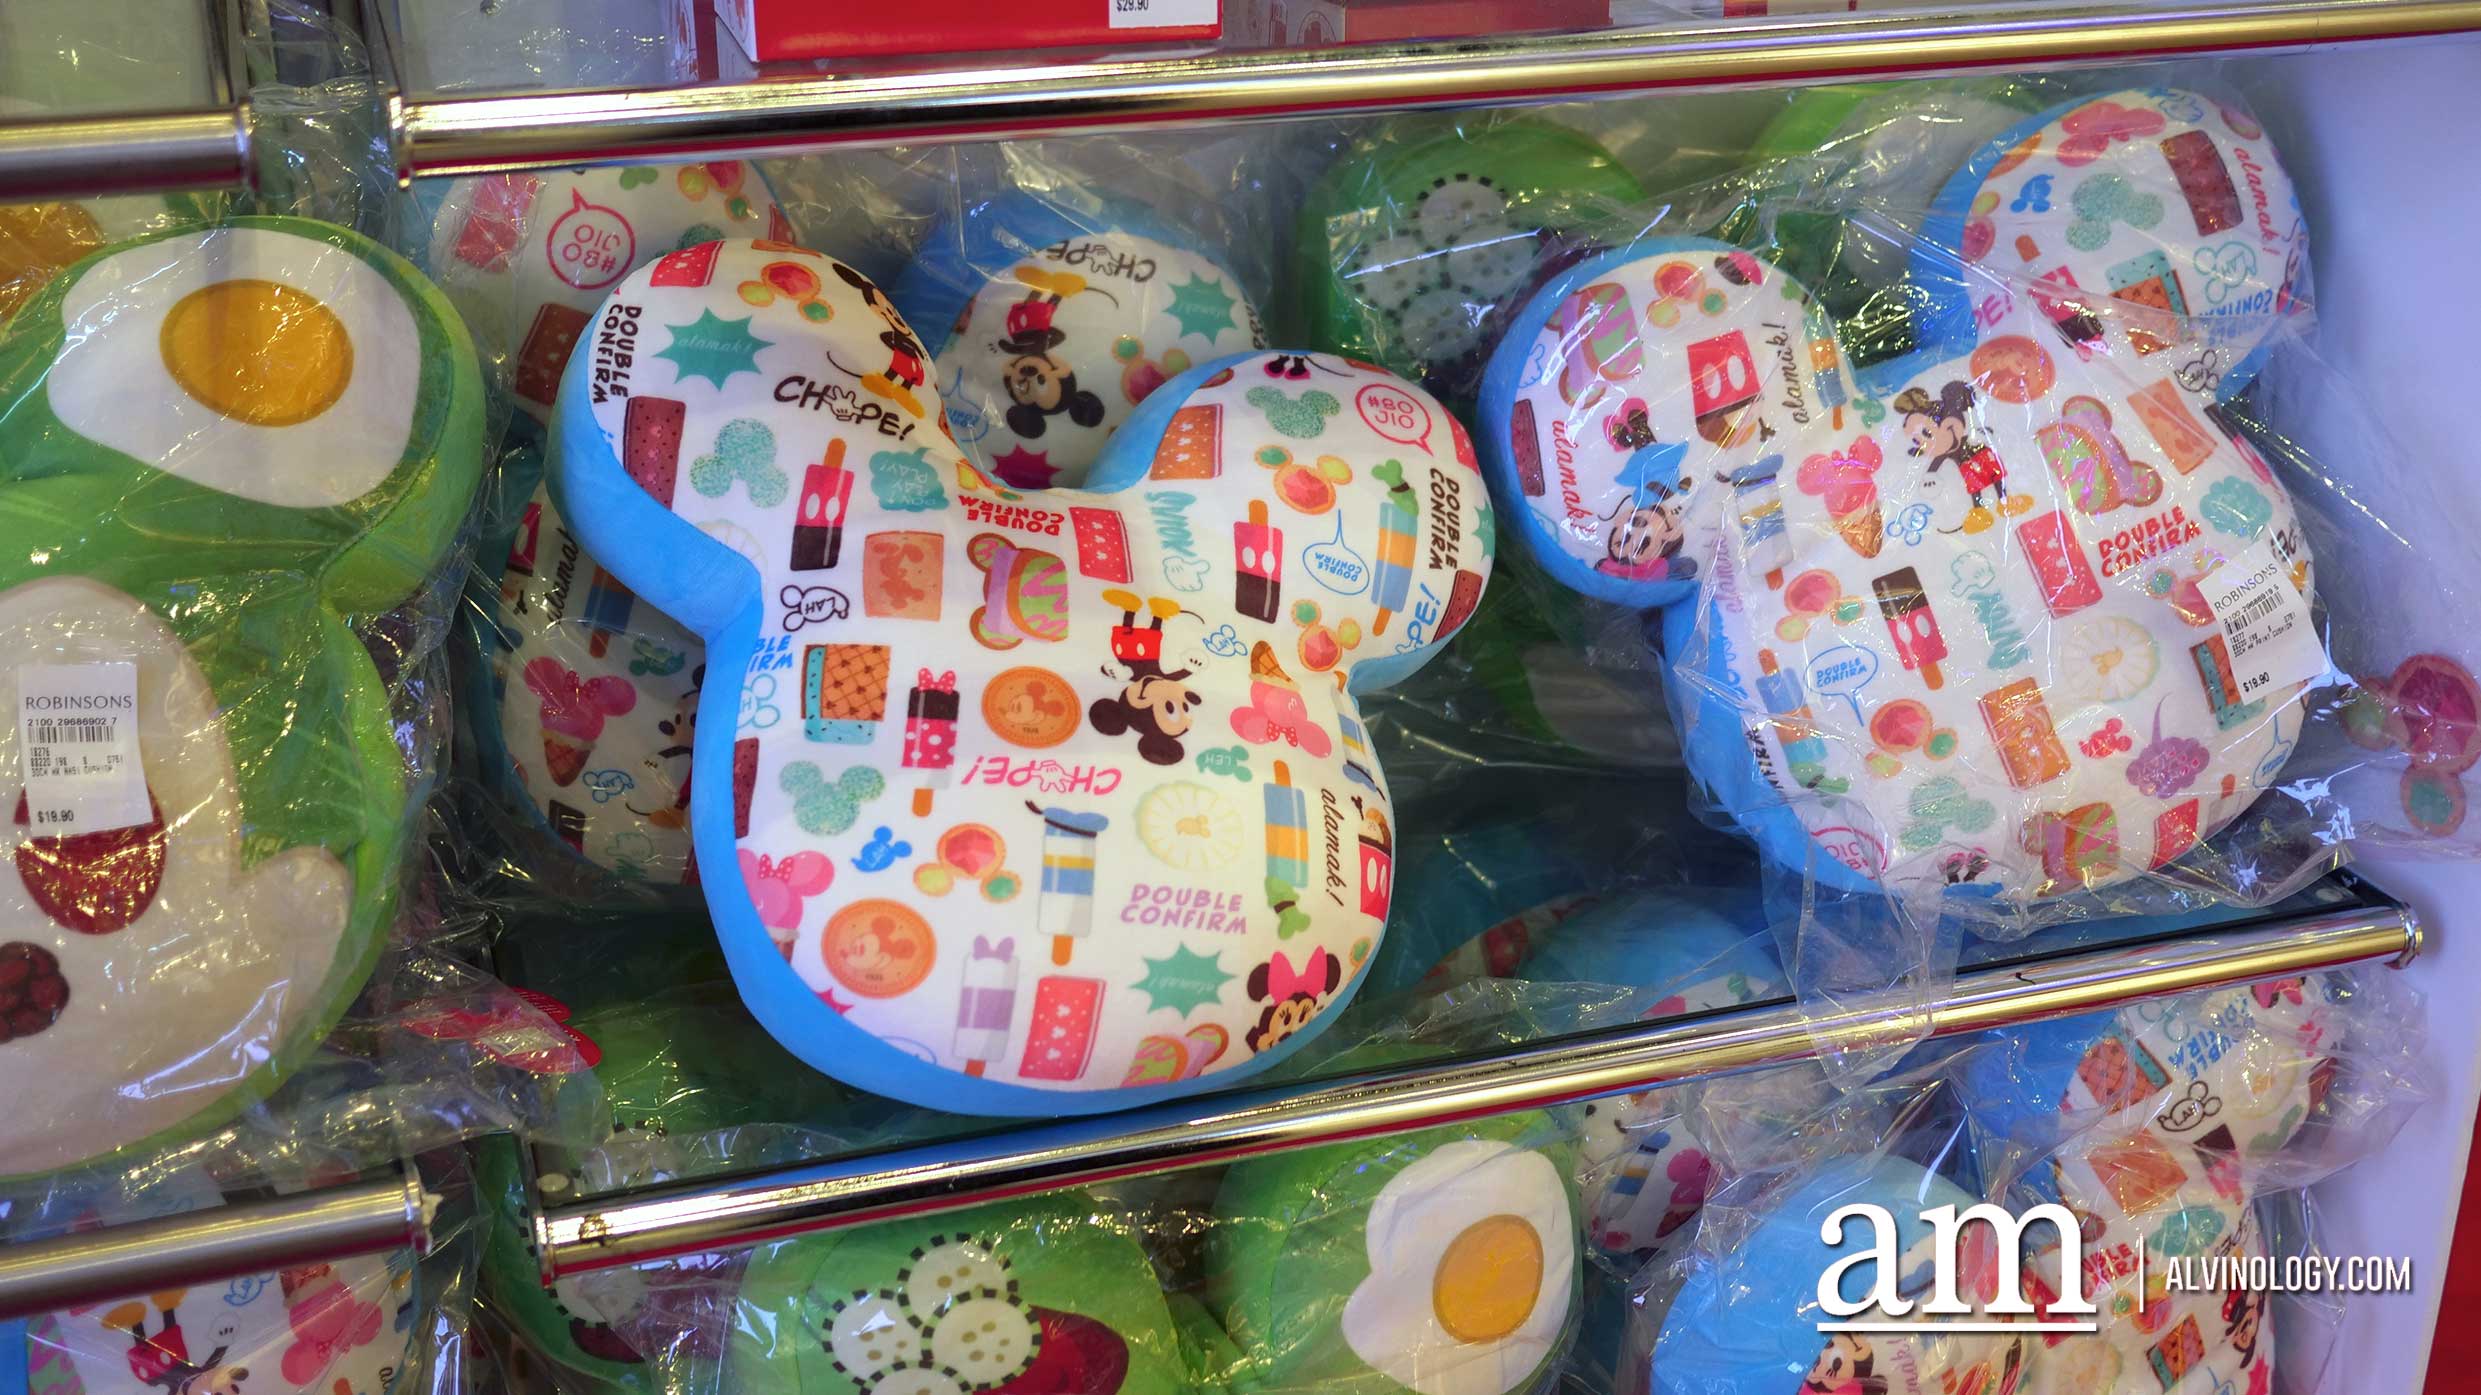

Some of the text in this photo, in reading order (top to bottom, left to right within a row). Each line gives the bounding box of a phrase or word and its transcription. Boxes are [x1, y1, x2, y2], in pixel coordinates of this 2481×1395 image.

[592, 303, 624, 405] CONFIRM
[610, 304, 643, 399] DOUBLE
[1368, 395, 1414, 416] #BO
[1374, 408, 1415, 431] JIO
[958, 495, 1065, 524] CONFIRM
[967, 509, 1061, 536] DOUBLE
[1428, 469, 1446, 572] CONFIRM
[1445, 479, 1461, 570] DOUBLE
[2098, 505, 2185, 559] DOUBLE
[1314, 550, 1364, 576] CONFIRM
[2101, 520, 2203, 577] CONFIRM
[1318, 561, 1360, 583] DOUBLE
[2213, 563, 2279, 613] ROBINSONS
[811, 598, 837, 618] LAH
[25, 695, 133, 710] ROBINSONS
[27, 718, 54, 727] 2100
[111, 717, 117, 725] 7
[1205, 752, 1233, 768] LEH
[1320, 787, 1346, 908] alamak!
[1131, 883, 1244, 912] DOUBLE
[1119, 904, 1248, 936] CONFIRM
